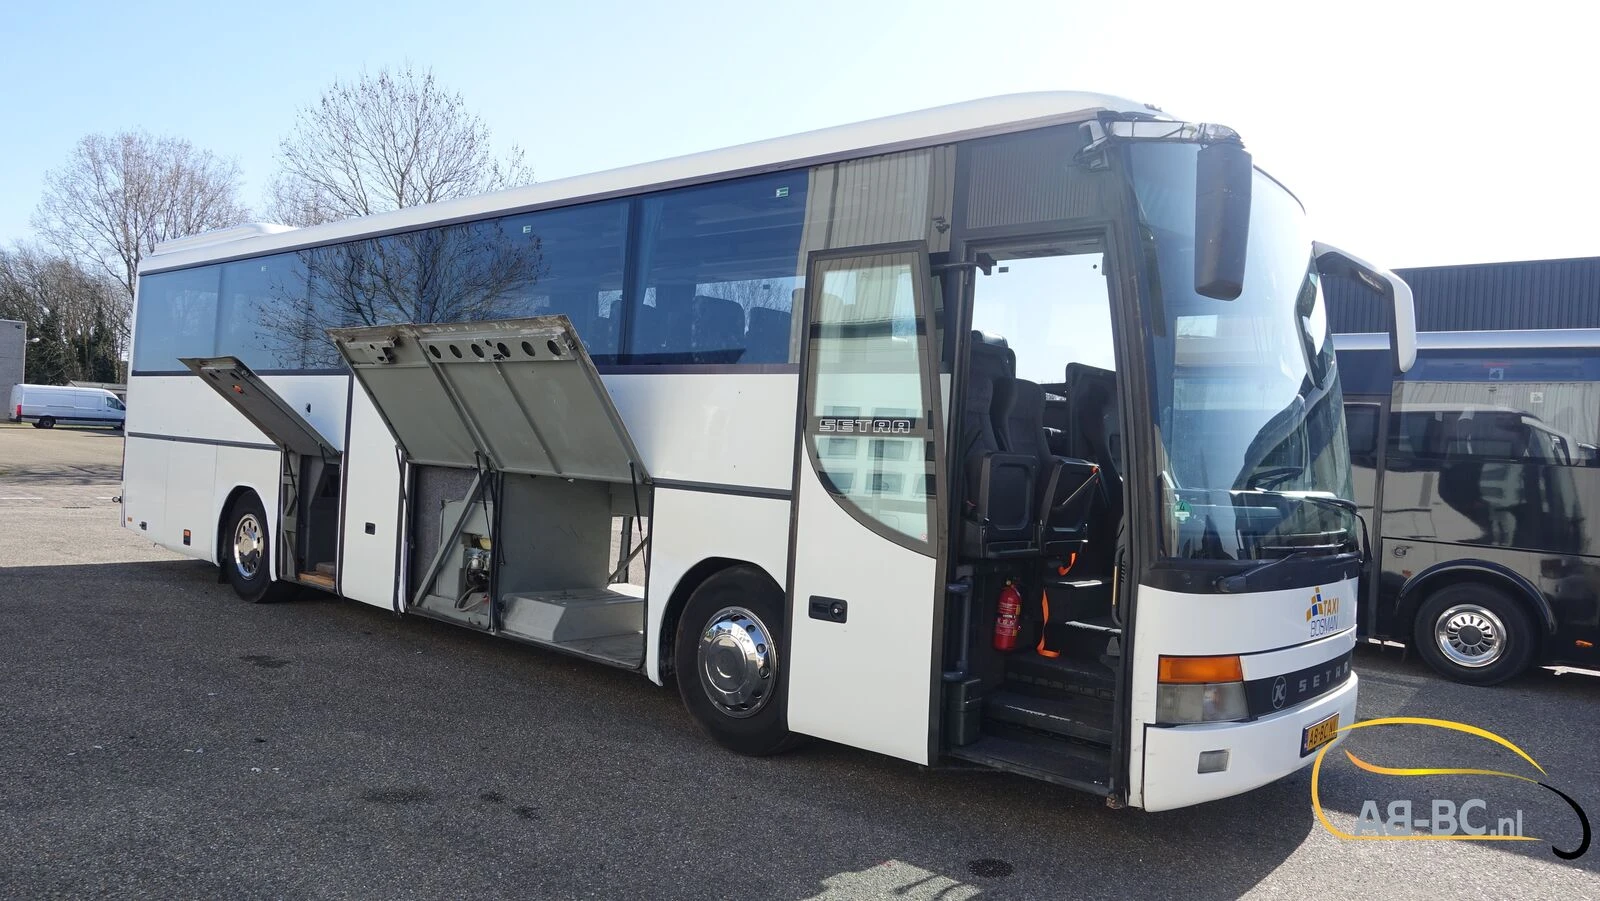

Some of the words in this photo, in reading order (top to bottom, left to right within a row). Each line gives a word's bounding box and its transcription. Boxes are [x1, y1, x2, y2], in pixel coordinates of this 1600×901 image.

[819, 419, 911, 433] SETRA
[1323, 597, 1340, 617] TAXI
[1310, 615, 1339, 638] BOSMAN
[1298, 661, 1349, 693] SETRA
